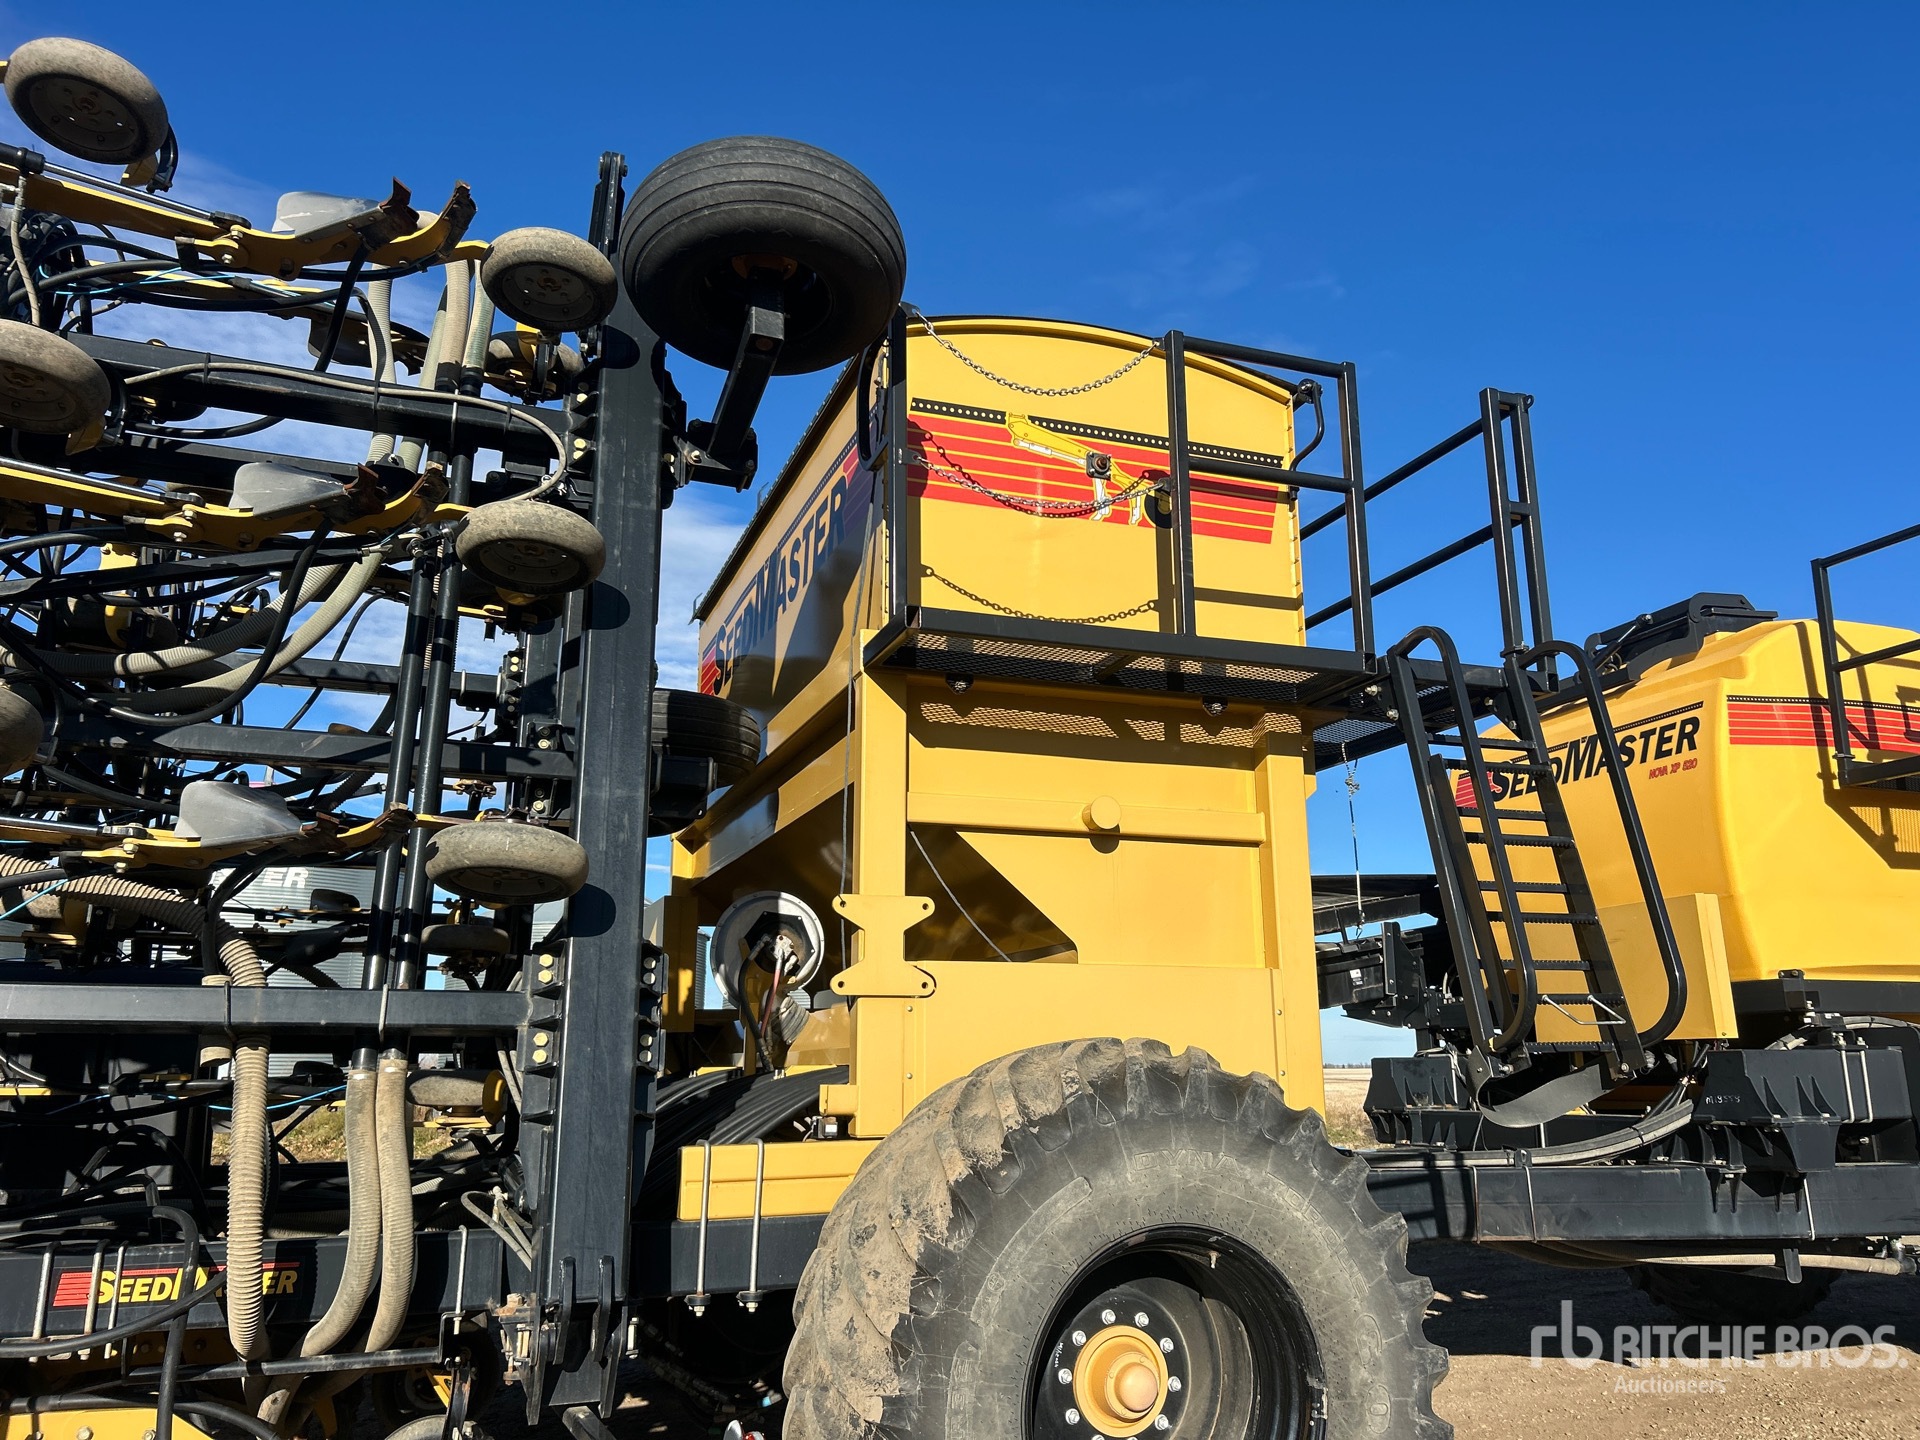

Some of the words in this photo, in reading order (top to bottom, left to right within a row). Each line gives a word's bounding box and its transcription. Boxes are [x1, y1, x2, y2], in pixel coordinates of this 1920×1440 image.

[713, 475, 848, 696] SEEDMASTER
[1648, 765, 1668, 780] NOVA
[97, 1266, 298, 1304] SEEDMER
